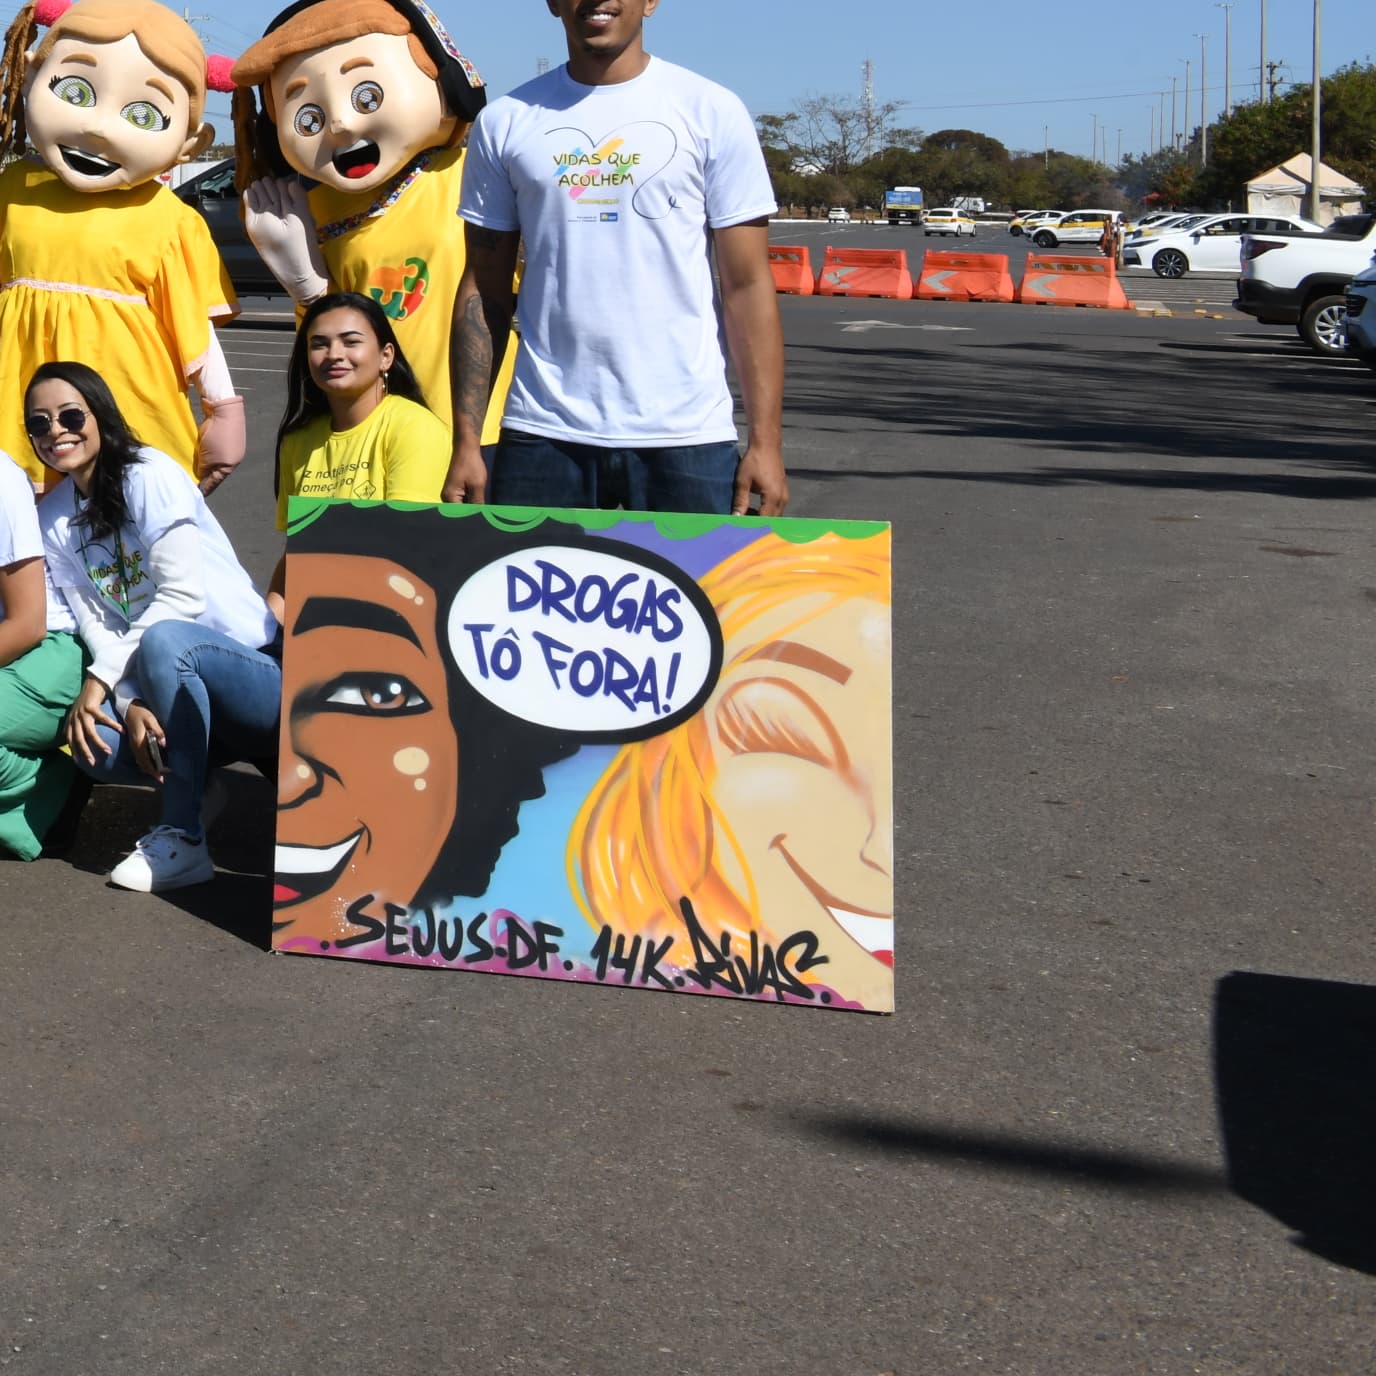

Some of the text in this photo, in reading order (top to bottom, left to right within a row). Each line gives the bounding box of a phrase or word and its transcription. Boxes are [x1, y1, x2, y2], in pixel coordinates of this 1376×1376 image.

[553, 153, 640, 166] VIDAS QUE
[558, 173, 634, 187] ACOLHEM
[506, 559, 683, 643] DROGAS
[463, 623, 683, 715] TÔ FORA!
